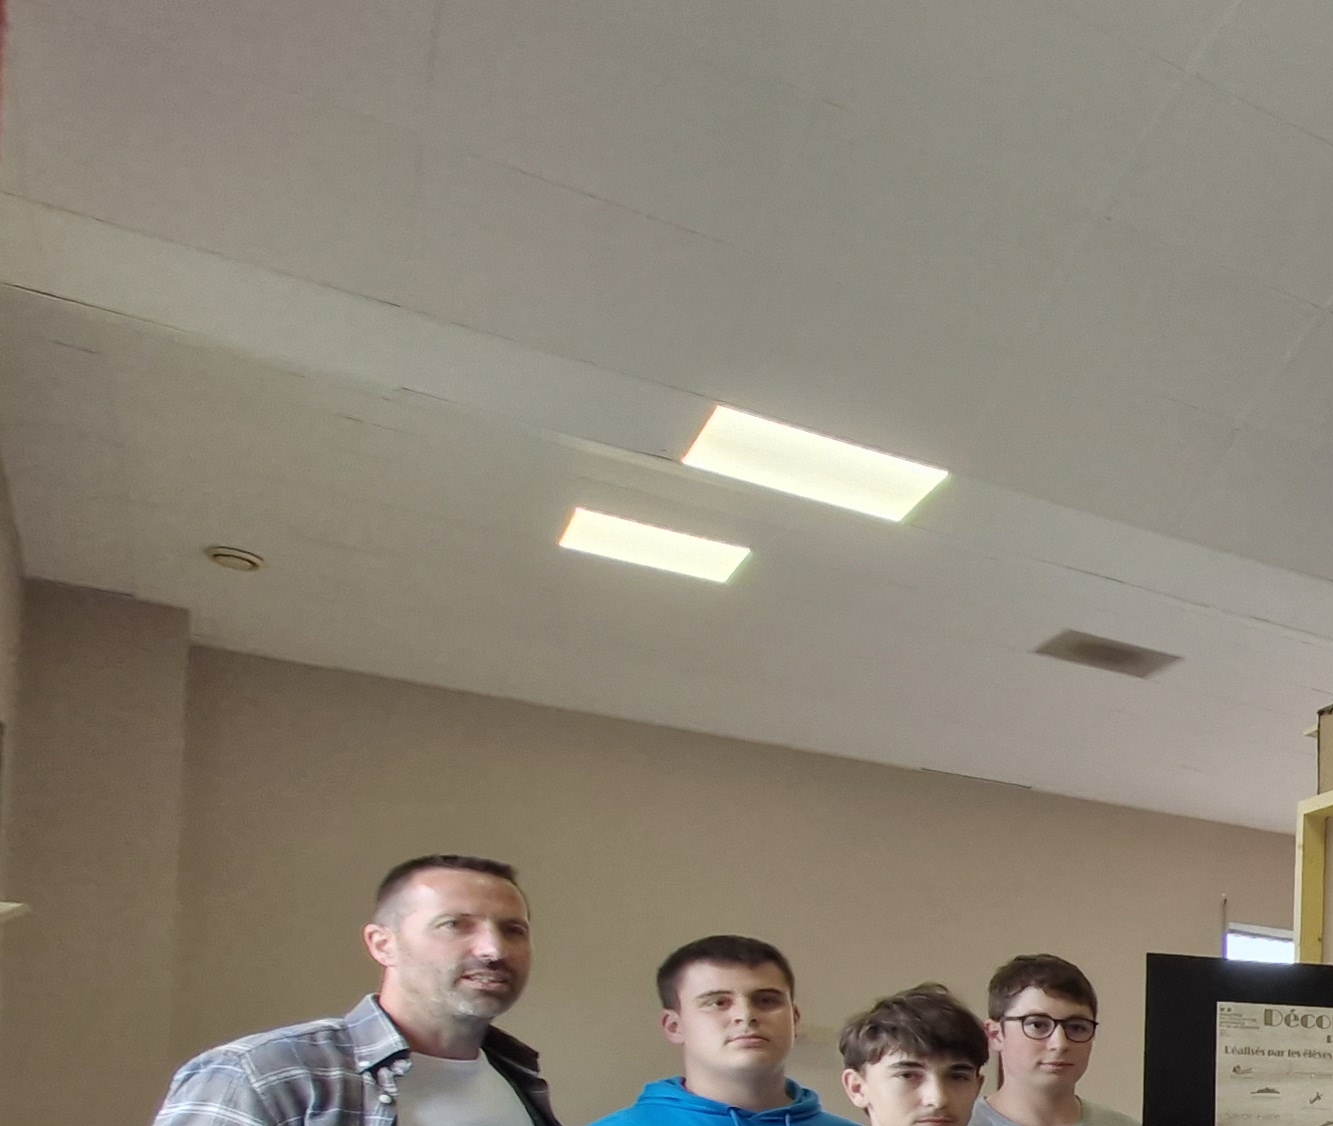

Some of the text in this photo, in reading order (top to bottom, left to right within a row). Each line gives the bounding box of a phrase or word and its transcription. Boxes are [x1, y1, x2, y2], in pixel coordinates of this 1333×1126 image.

[1267, 1049, 1285, 1058] par
[1287, 1049, 1300, 1058] les
[1302, 1049, 1333, 1059] élèves
